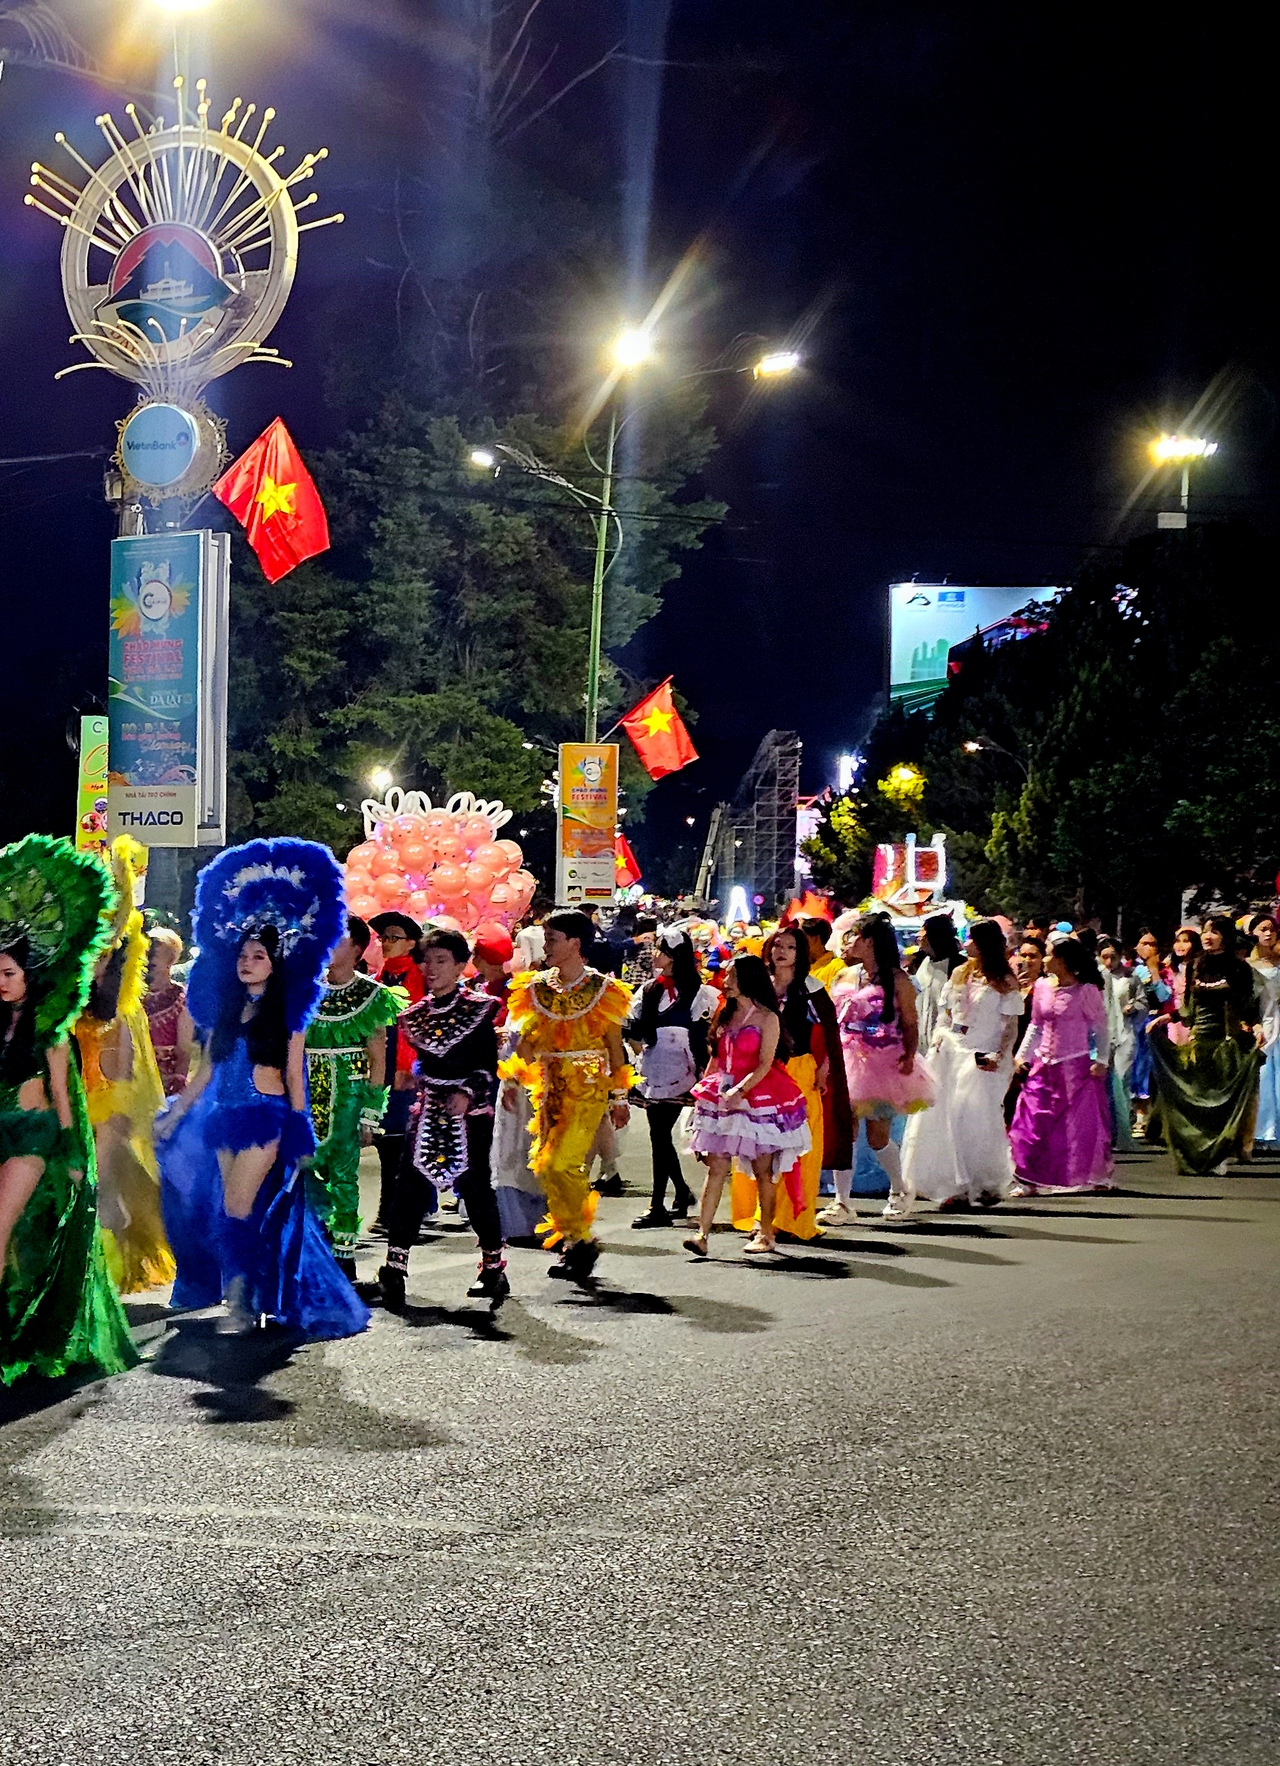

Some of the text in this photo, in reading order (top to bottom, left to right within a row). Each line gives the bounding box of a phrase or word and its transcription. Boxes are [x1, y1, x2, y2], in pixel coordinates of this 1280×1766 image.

[126, 440, 176, 451] VietinBank
[124, 650, 183, 667] FESTIVAL
[118, 811, 183, 826] THACO
